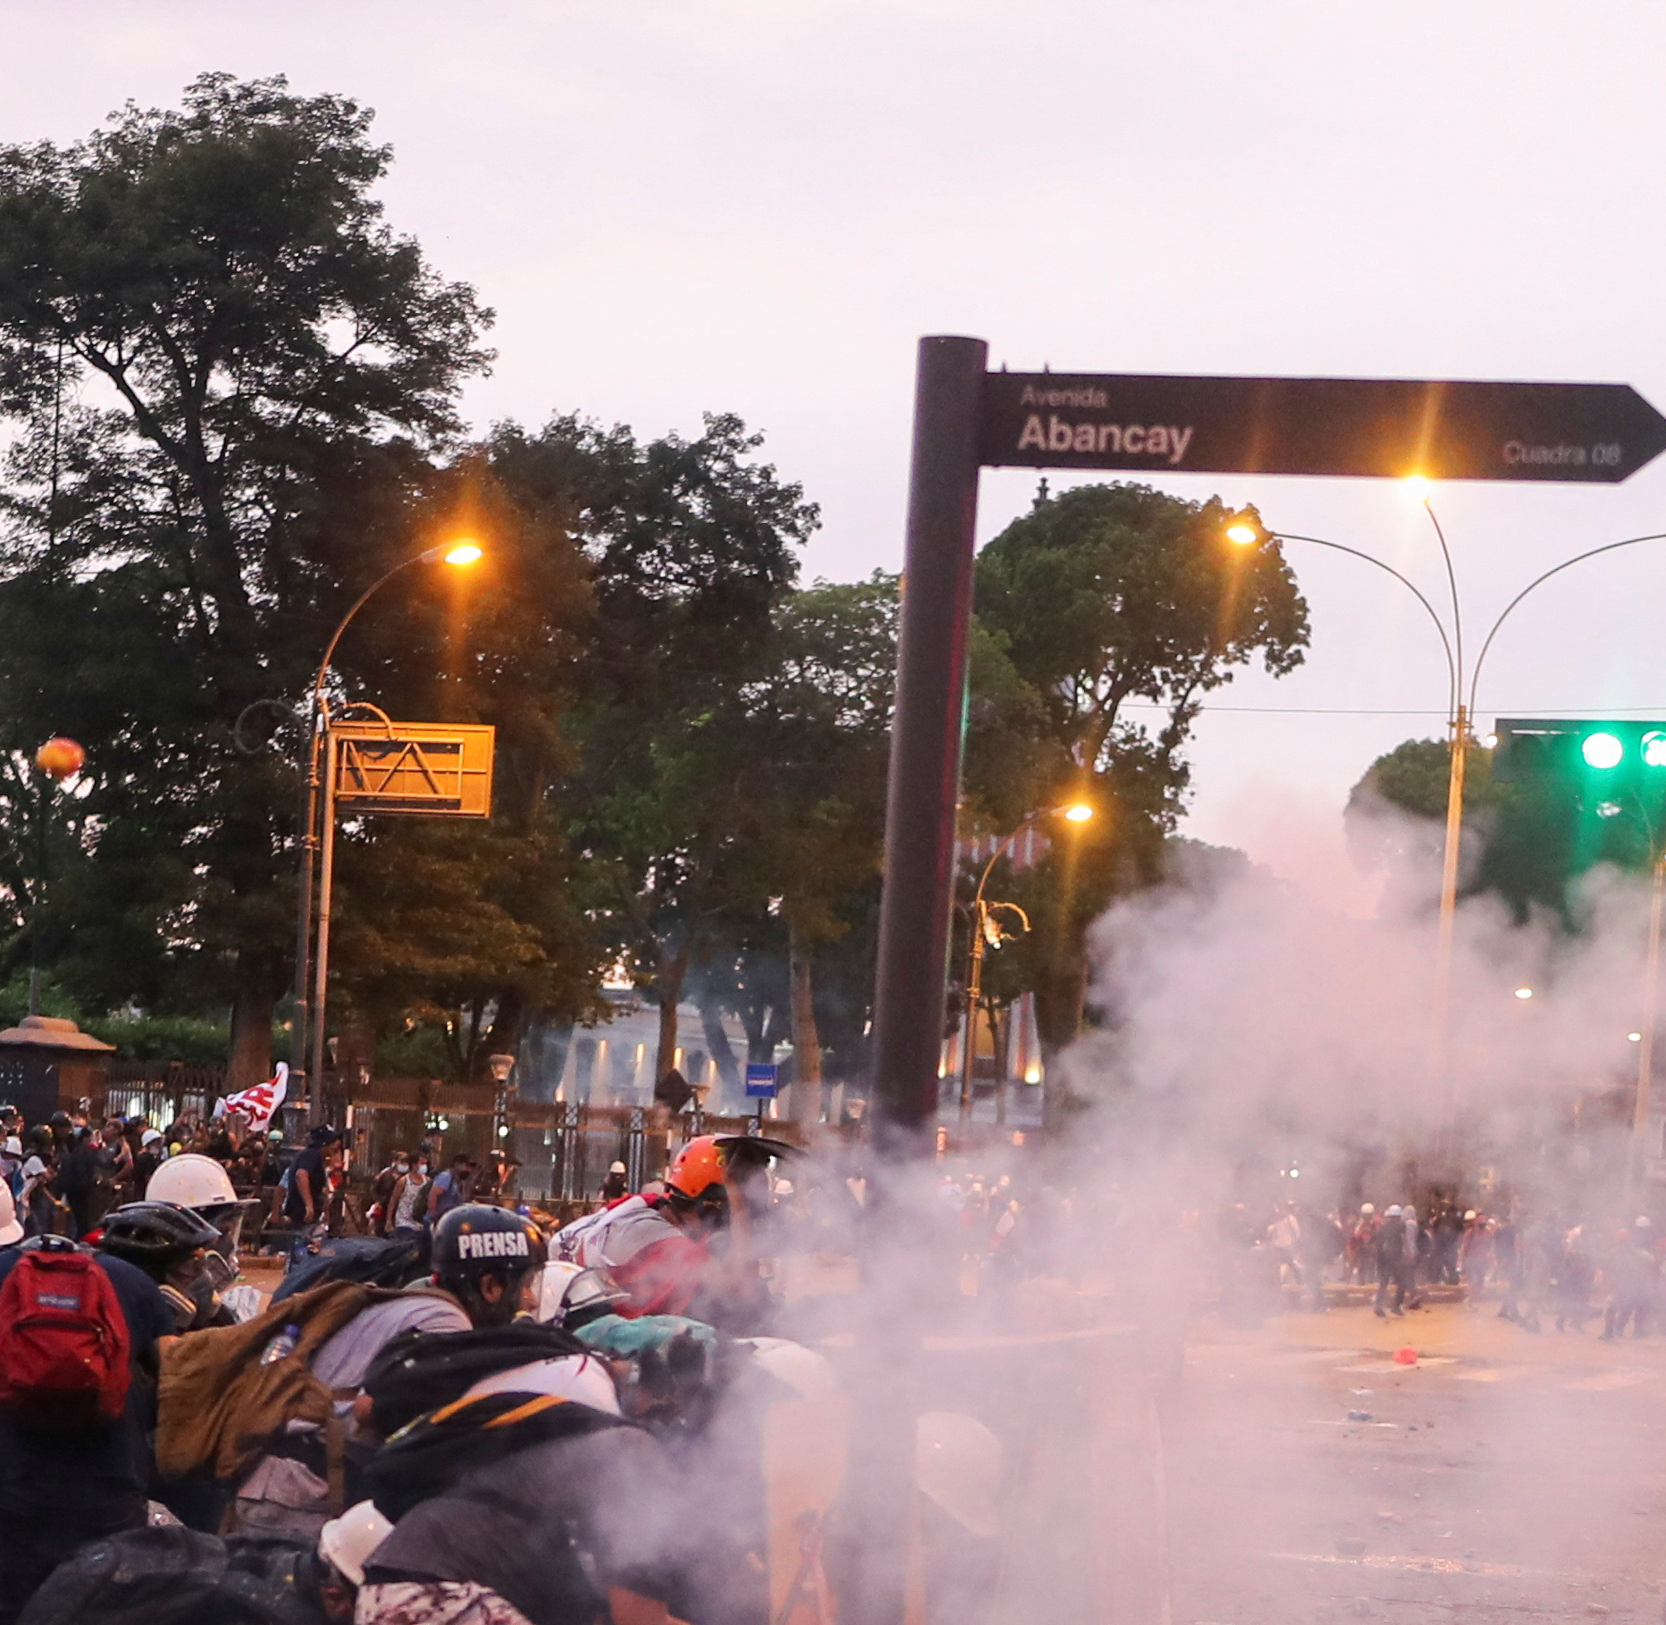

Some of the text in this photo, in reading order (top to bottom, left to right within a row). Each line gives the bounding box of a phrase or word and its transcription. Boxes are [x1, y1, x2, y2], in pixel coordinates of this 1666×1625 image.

[1022, 385, 1109, 408] Avenida
[1017, 413, 1194, 465] Abancay
[1502, 440, 1586, 465] Cuadra
[457, 1231, 529, 1260] PRENSA
